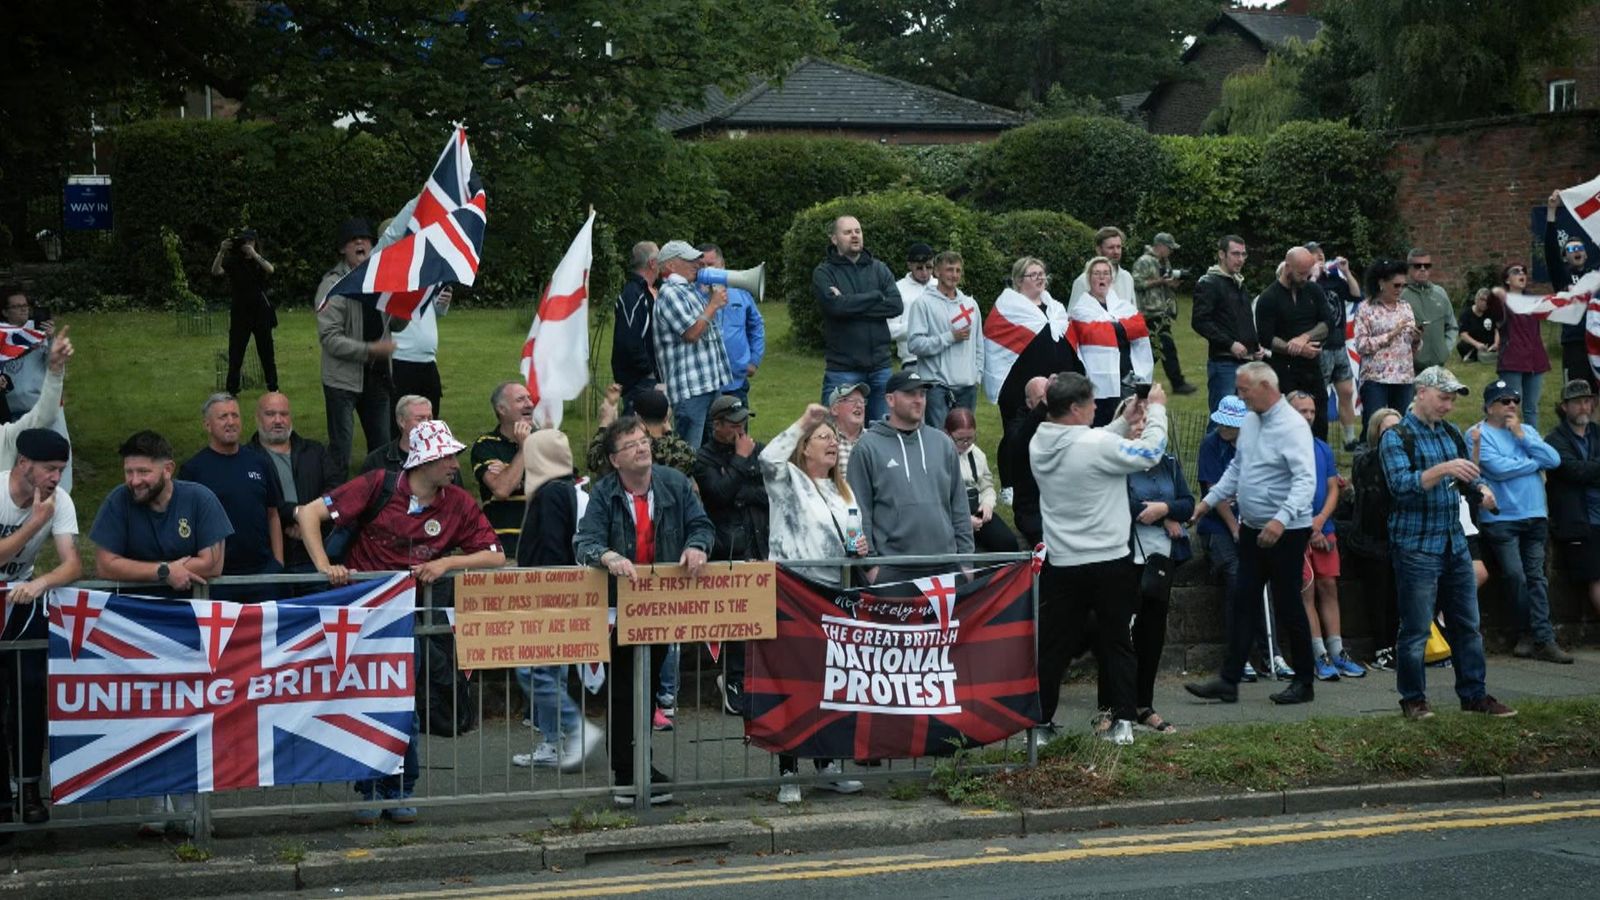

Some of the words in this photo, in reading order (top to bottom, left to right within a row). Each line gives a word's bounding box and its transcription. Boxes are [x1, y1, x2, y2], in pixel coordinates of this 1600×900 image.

[70, 202, 95, 212] WAY
[97, 202, 109, 212] IN
[463, 573, 487, 586] HOW
[494, 571, 519, 585] MANY
[629, 576, 653, 591] THE
[659, 576, 692, 591] FIRST
[695, 574, 753, 589] PRIORITY
[756, 573, 771, 587] OF
[463, 596, 477, 611] DID
[482, 596, 504, 611] THEY
[508, 595, 531, 610] PASS
[535, 593, 579, 608] THROUGH
[585, 592, 599, 606] TO
[625, 600, 710, 617] GOVERNMENT
[714, 600, 724, 613] IS
[728, 599, 748, 613] THE
[462, 622, 481, 636] GET
[485, 621, 514, 636] HERE?
[520, 619, 544, 634] THEY
[548, 618, 565, 633] ARE
[569, 617, 591, 632] HERE
[628, 626, 669, 642] SAFETY
[674, 626, 687, 640] OF
[691, 625, 707, 639] ITS
[709, 622, 762, 638] CITIZENS
[821, 623, 849, 641] THE
[852, 629, 899, 646] GREAT
[904, 629, 959, 646] BRITISH
[467, 648, 485, 662] FOR
[492, 646, 515, 661] FREE
[519, 645, 555, 659] HOUSING
[562, 643, 600, 658] BENEFITS
[826, 639, 954, 673] NATIONAL
[57, 678, 235, 712] UNITING
[247, 660, 407, 700] BRITAIN
[823, 667, 957, 706] PROTEST
